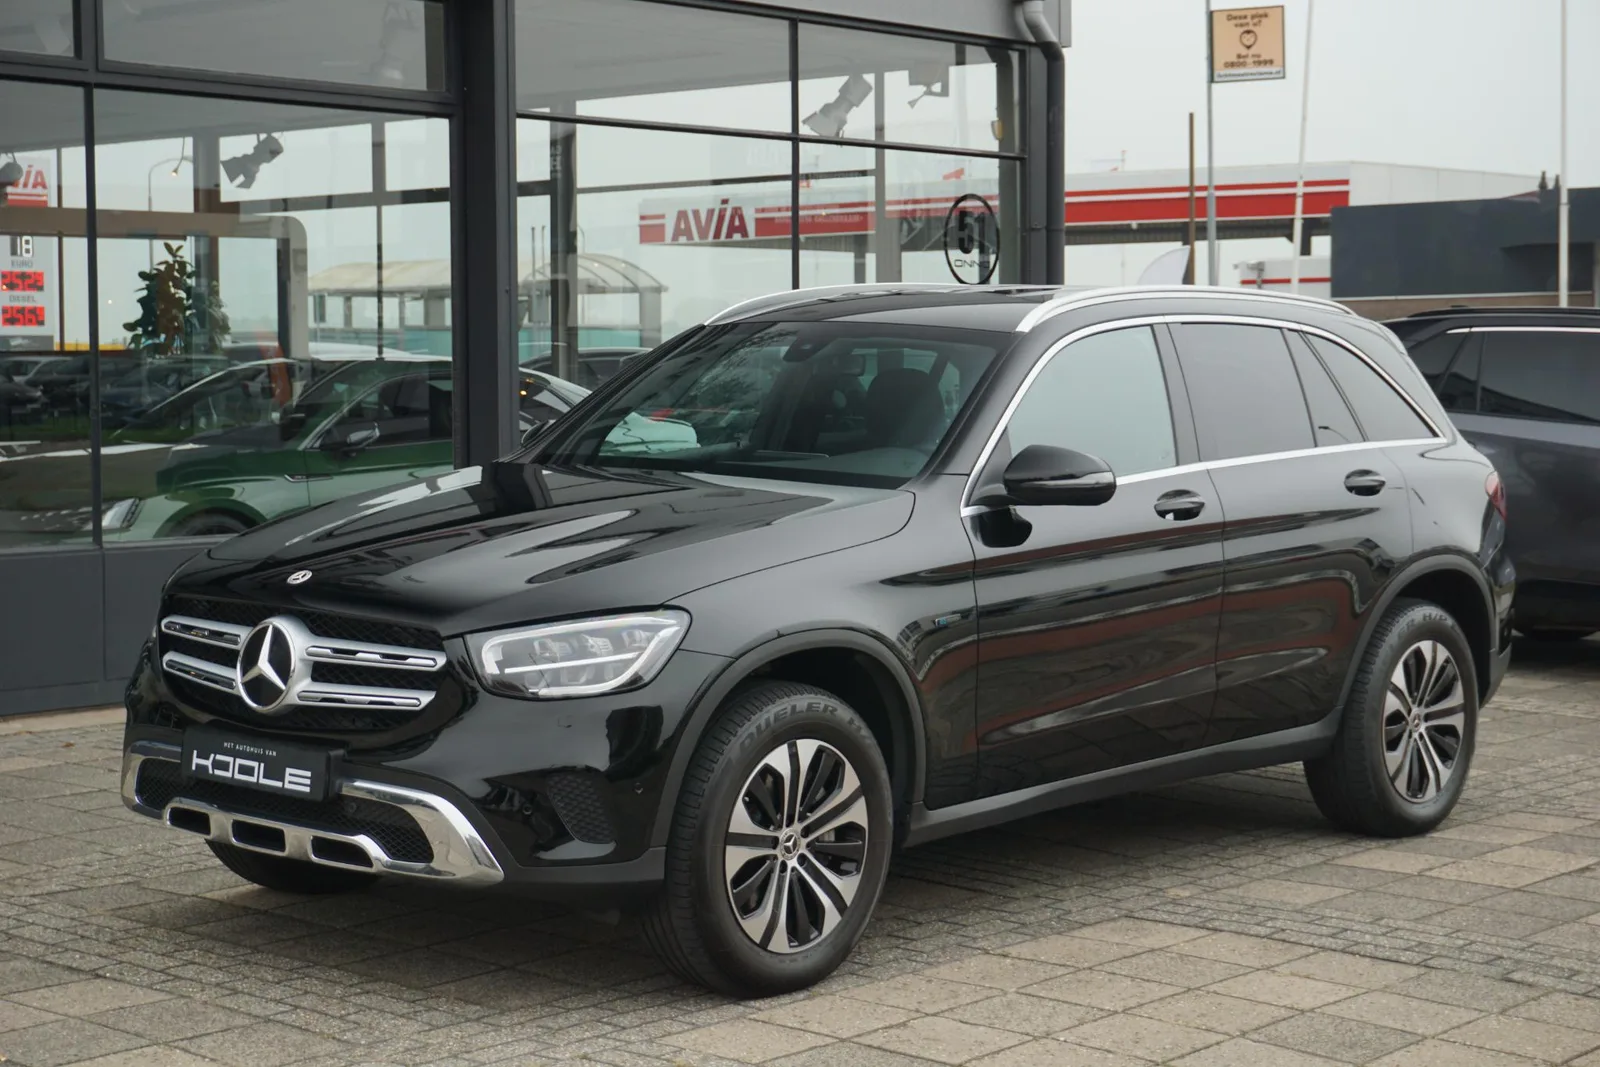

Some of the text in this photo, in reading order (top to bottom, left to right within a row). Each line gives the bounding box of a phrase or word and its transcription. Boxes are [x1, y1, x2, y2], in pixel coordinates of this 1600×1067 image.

[958, 210, 985, 255] 51
[223, 741, 277, 757] HET AUTOHUIS VAN
